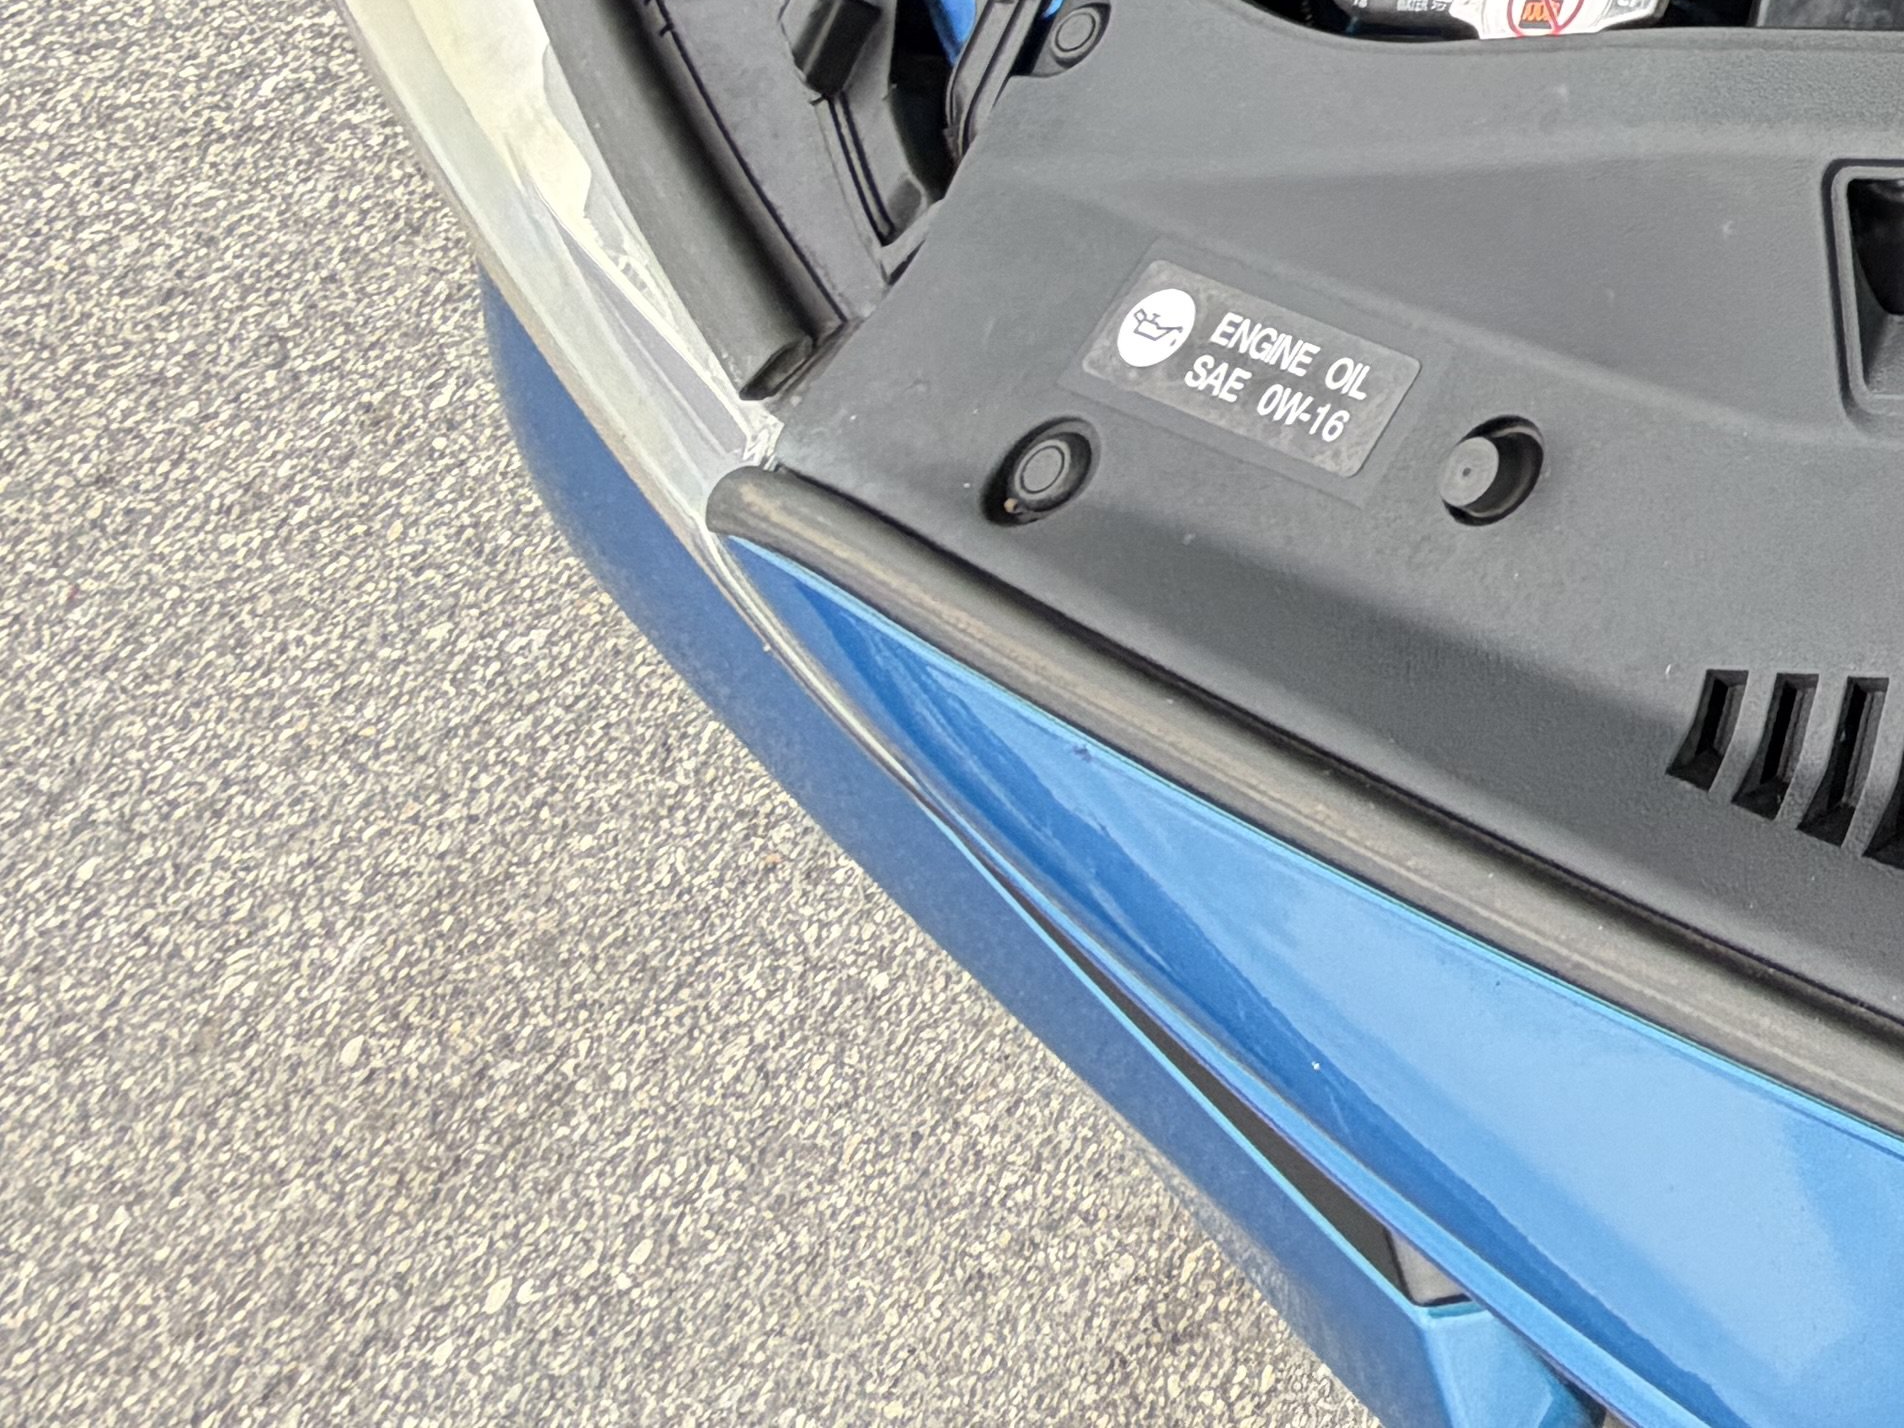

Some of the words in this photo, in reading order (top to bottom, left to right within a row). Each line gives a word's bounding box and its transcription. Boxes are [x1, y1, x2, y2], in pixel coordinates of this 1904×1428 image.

[1184, 355, 1252, 405] SAE
[1256, 382, 1351, 443] 0W-16
[1210, 312, 1320, 377] ENGINE
[1324, 357, 1371, 401] OIL
